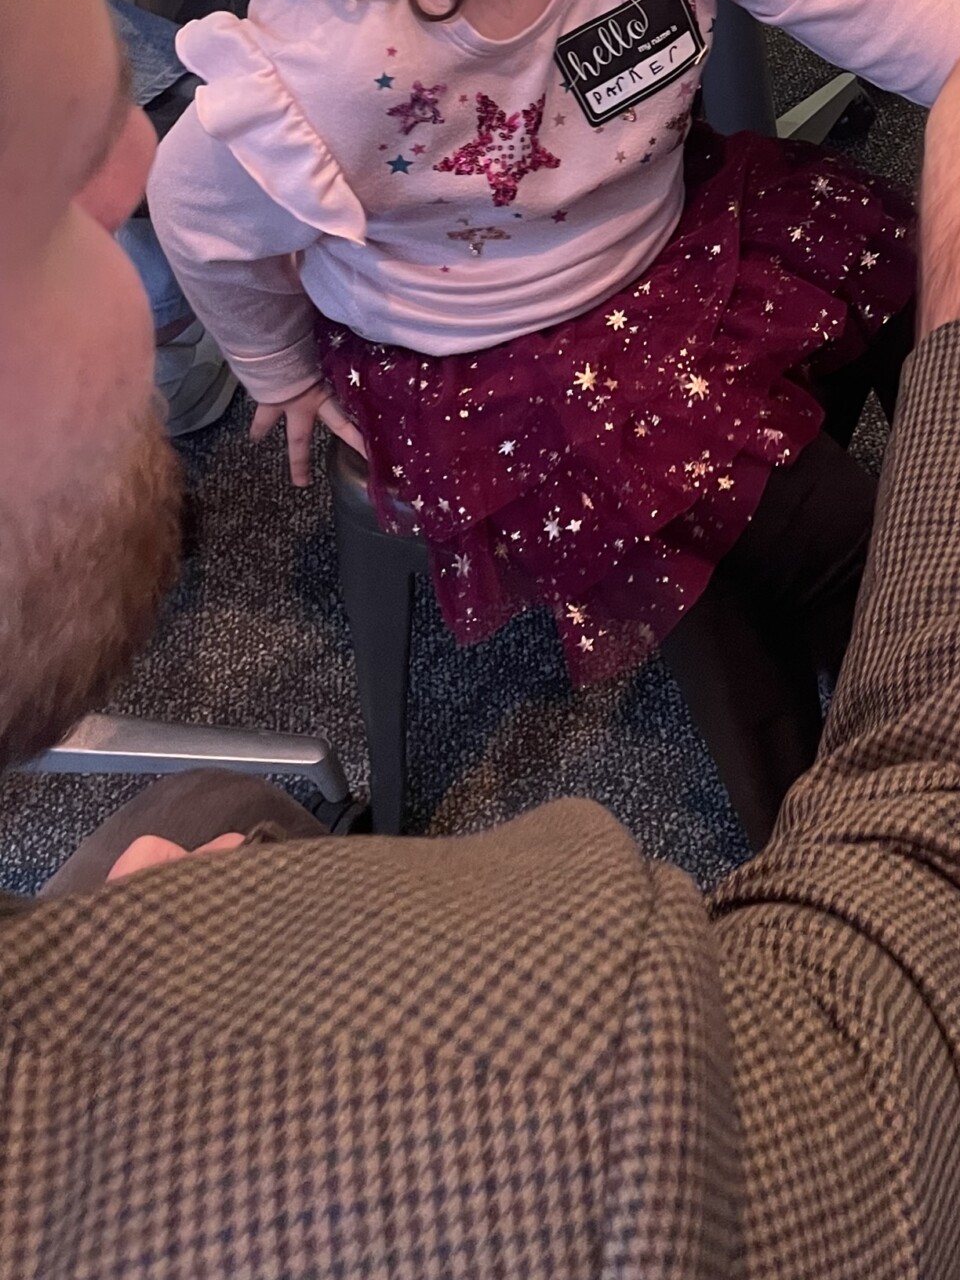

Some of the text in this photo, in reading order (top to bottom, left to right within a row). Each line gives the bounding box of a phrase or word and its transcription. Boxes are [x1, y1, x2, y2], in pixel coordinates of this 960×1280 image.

[567, 0, 649, 87] hello
[637, 24, 678, 53] my name is
